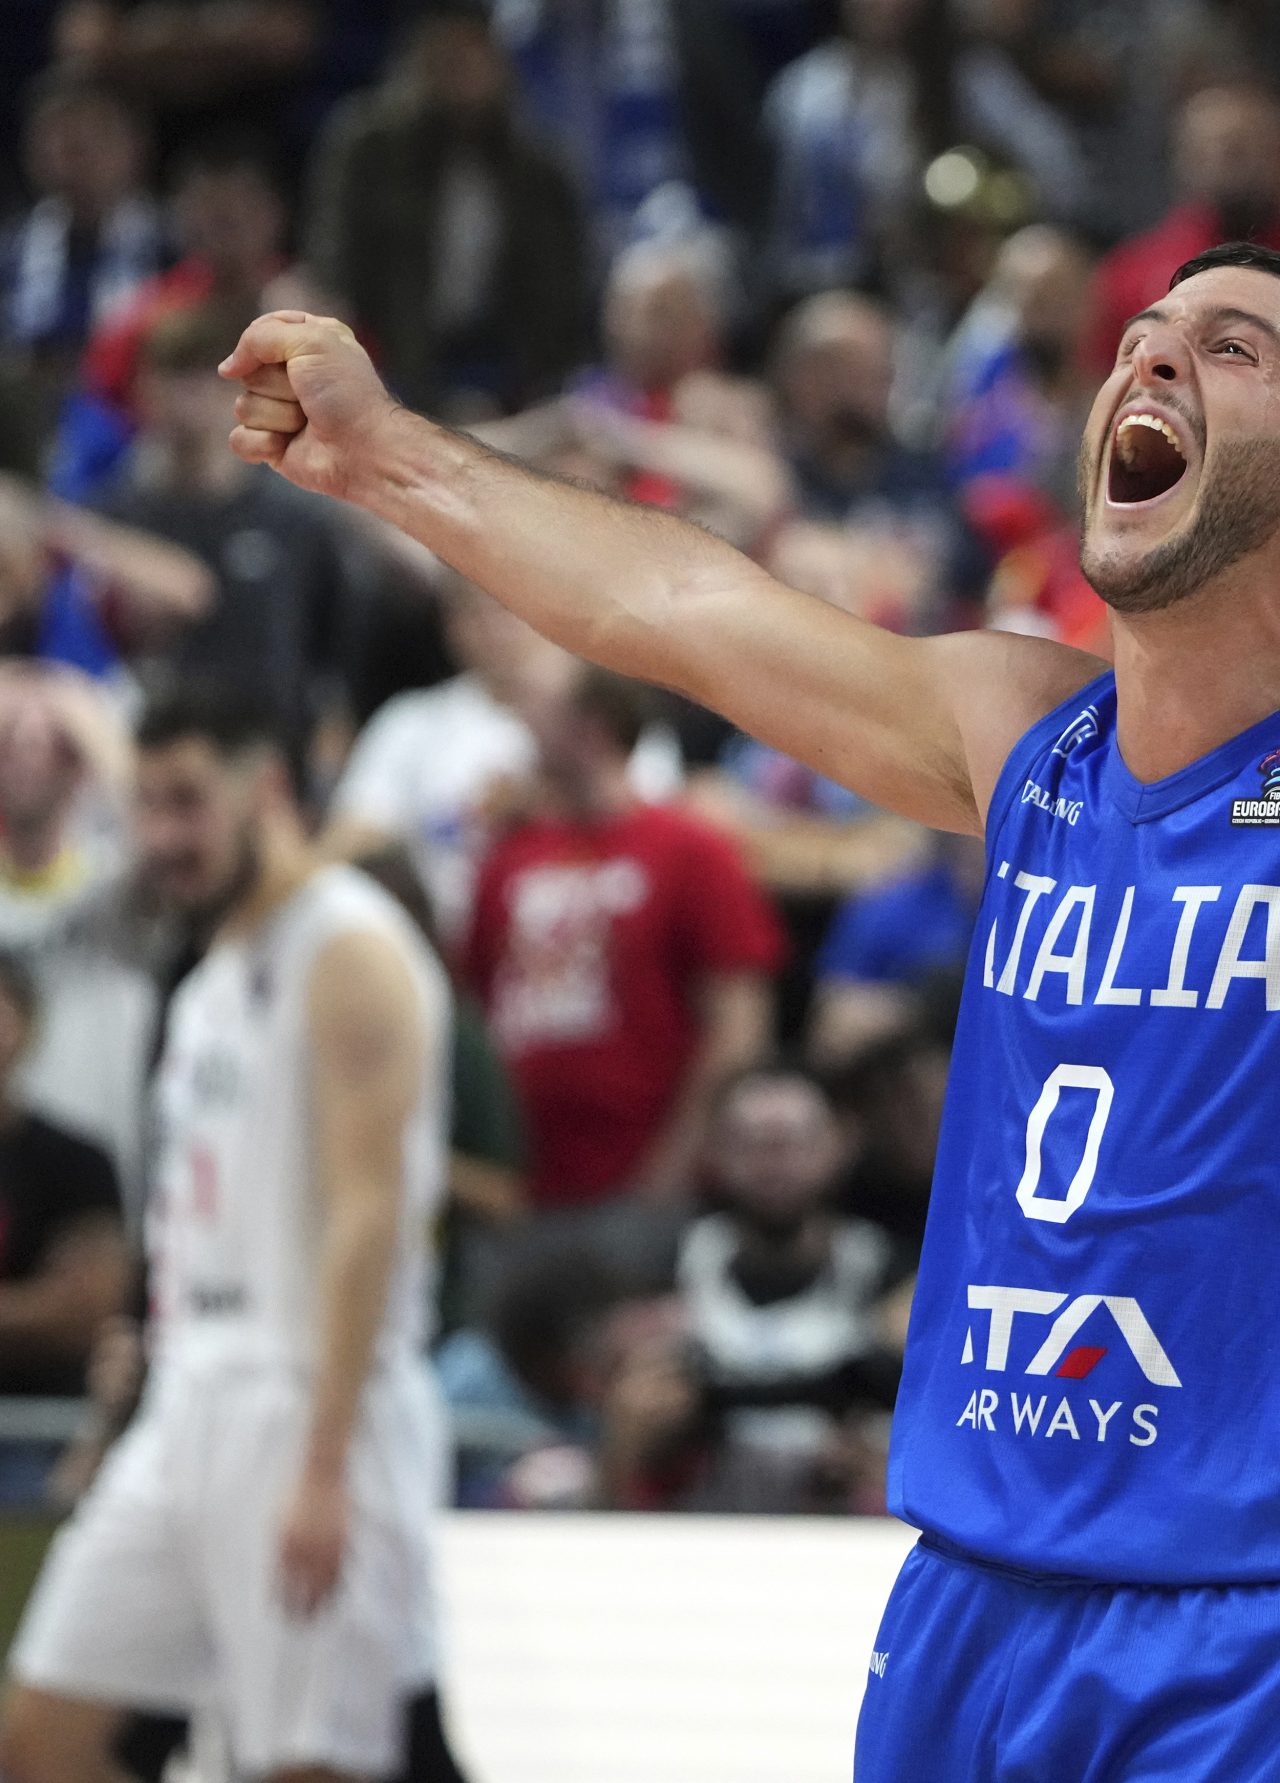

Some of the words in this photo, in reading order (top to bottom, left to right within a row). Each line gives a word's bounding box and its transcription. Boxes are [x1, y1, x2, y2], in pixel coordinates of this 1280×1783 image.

[1015, 1063, 1115, 1223] 0
[961, 1284, 1183, 1388] TA
[955, 1388, 1159, 1447] ARWAYS
